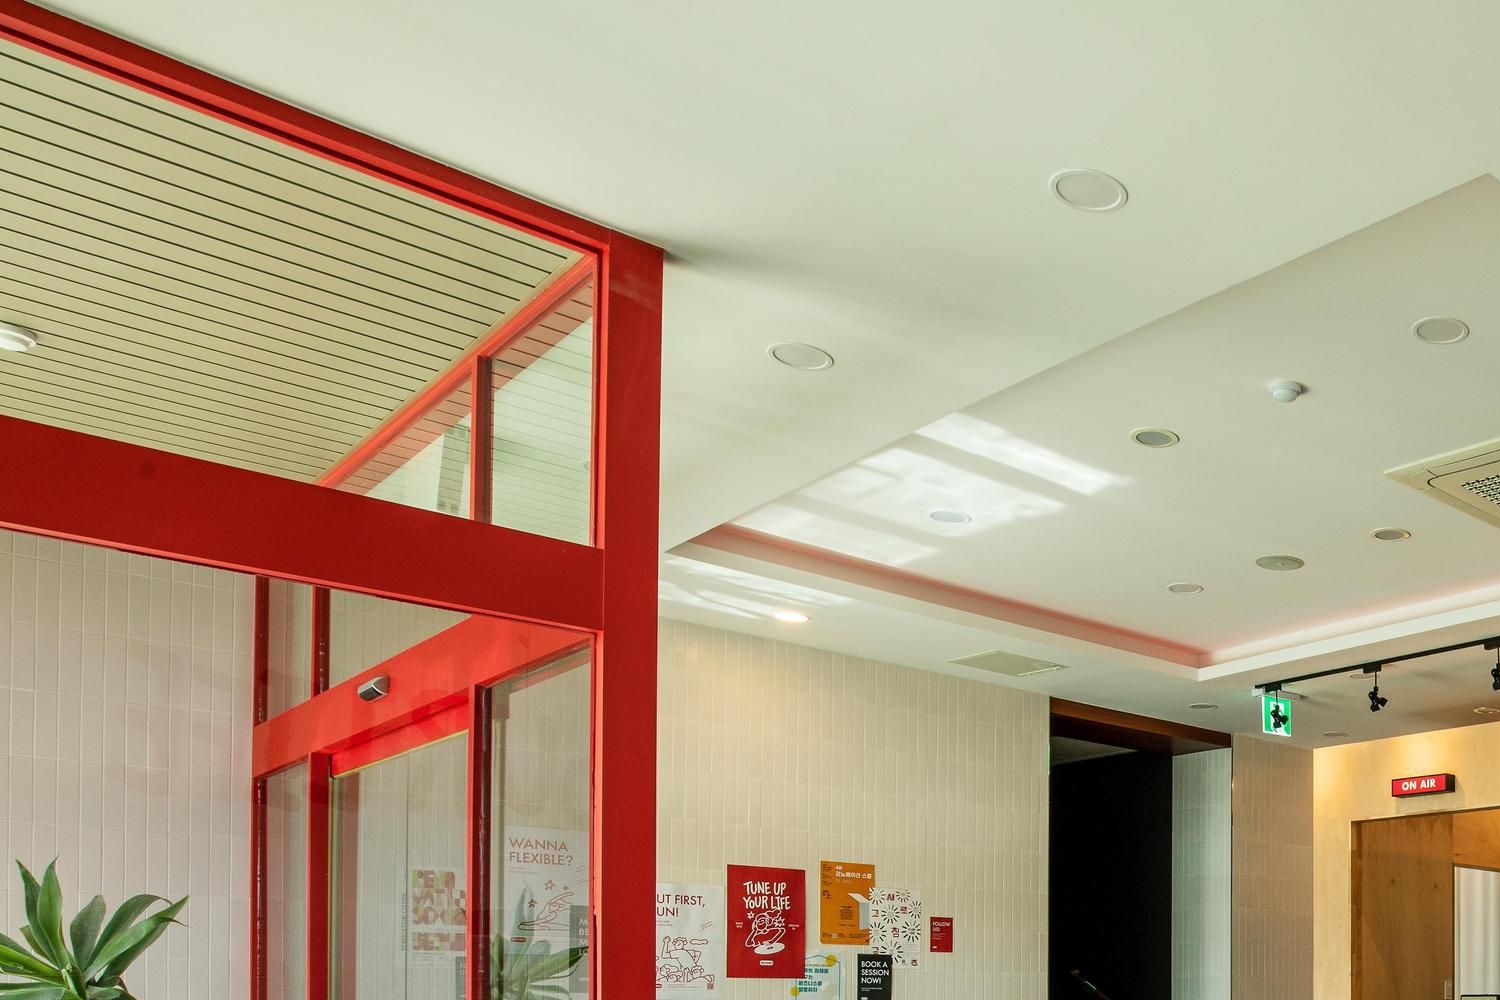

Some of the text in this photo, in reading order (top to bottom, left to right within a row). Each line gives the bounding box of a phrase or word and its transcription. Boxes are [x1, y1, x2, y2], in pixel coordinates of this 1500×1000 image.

[1401, 778, 1436, 791] ON AIR
[508, 837, 569, 852] WANNA
[509, 851, 574, 866] FLEXIBLE?
[743, 881, 787, 895] TUNE UP
[656, 894, 705, 907] UT FIRST,
[742, 896, 791, 910] YOUR LIFE
[656, 907, 679, 917] UN!
